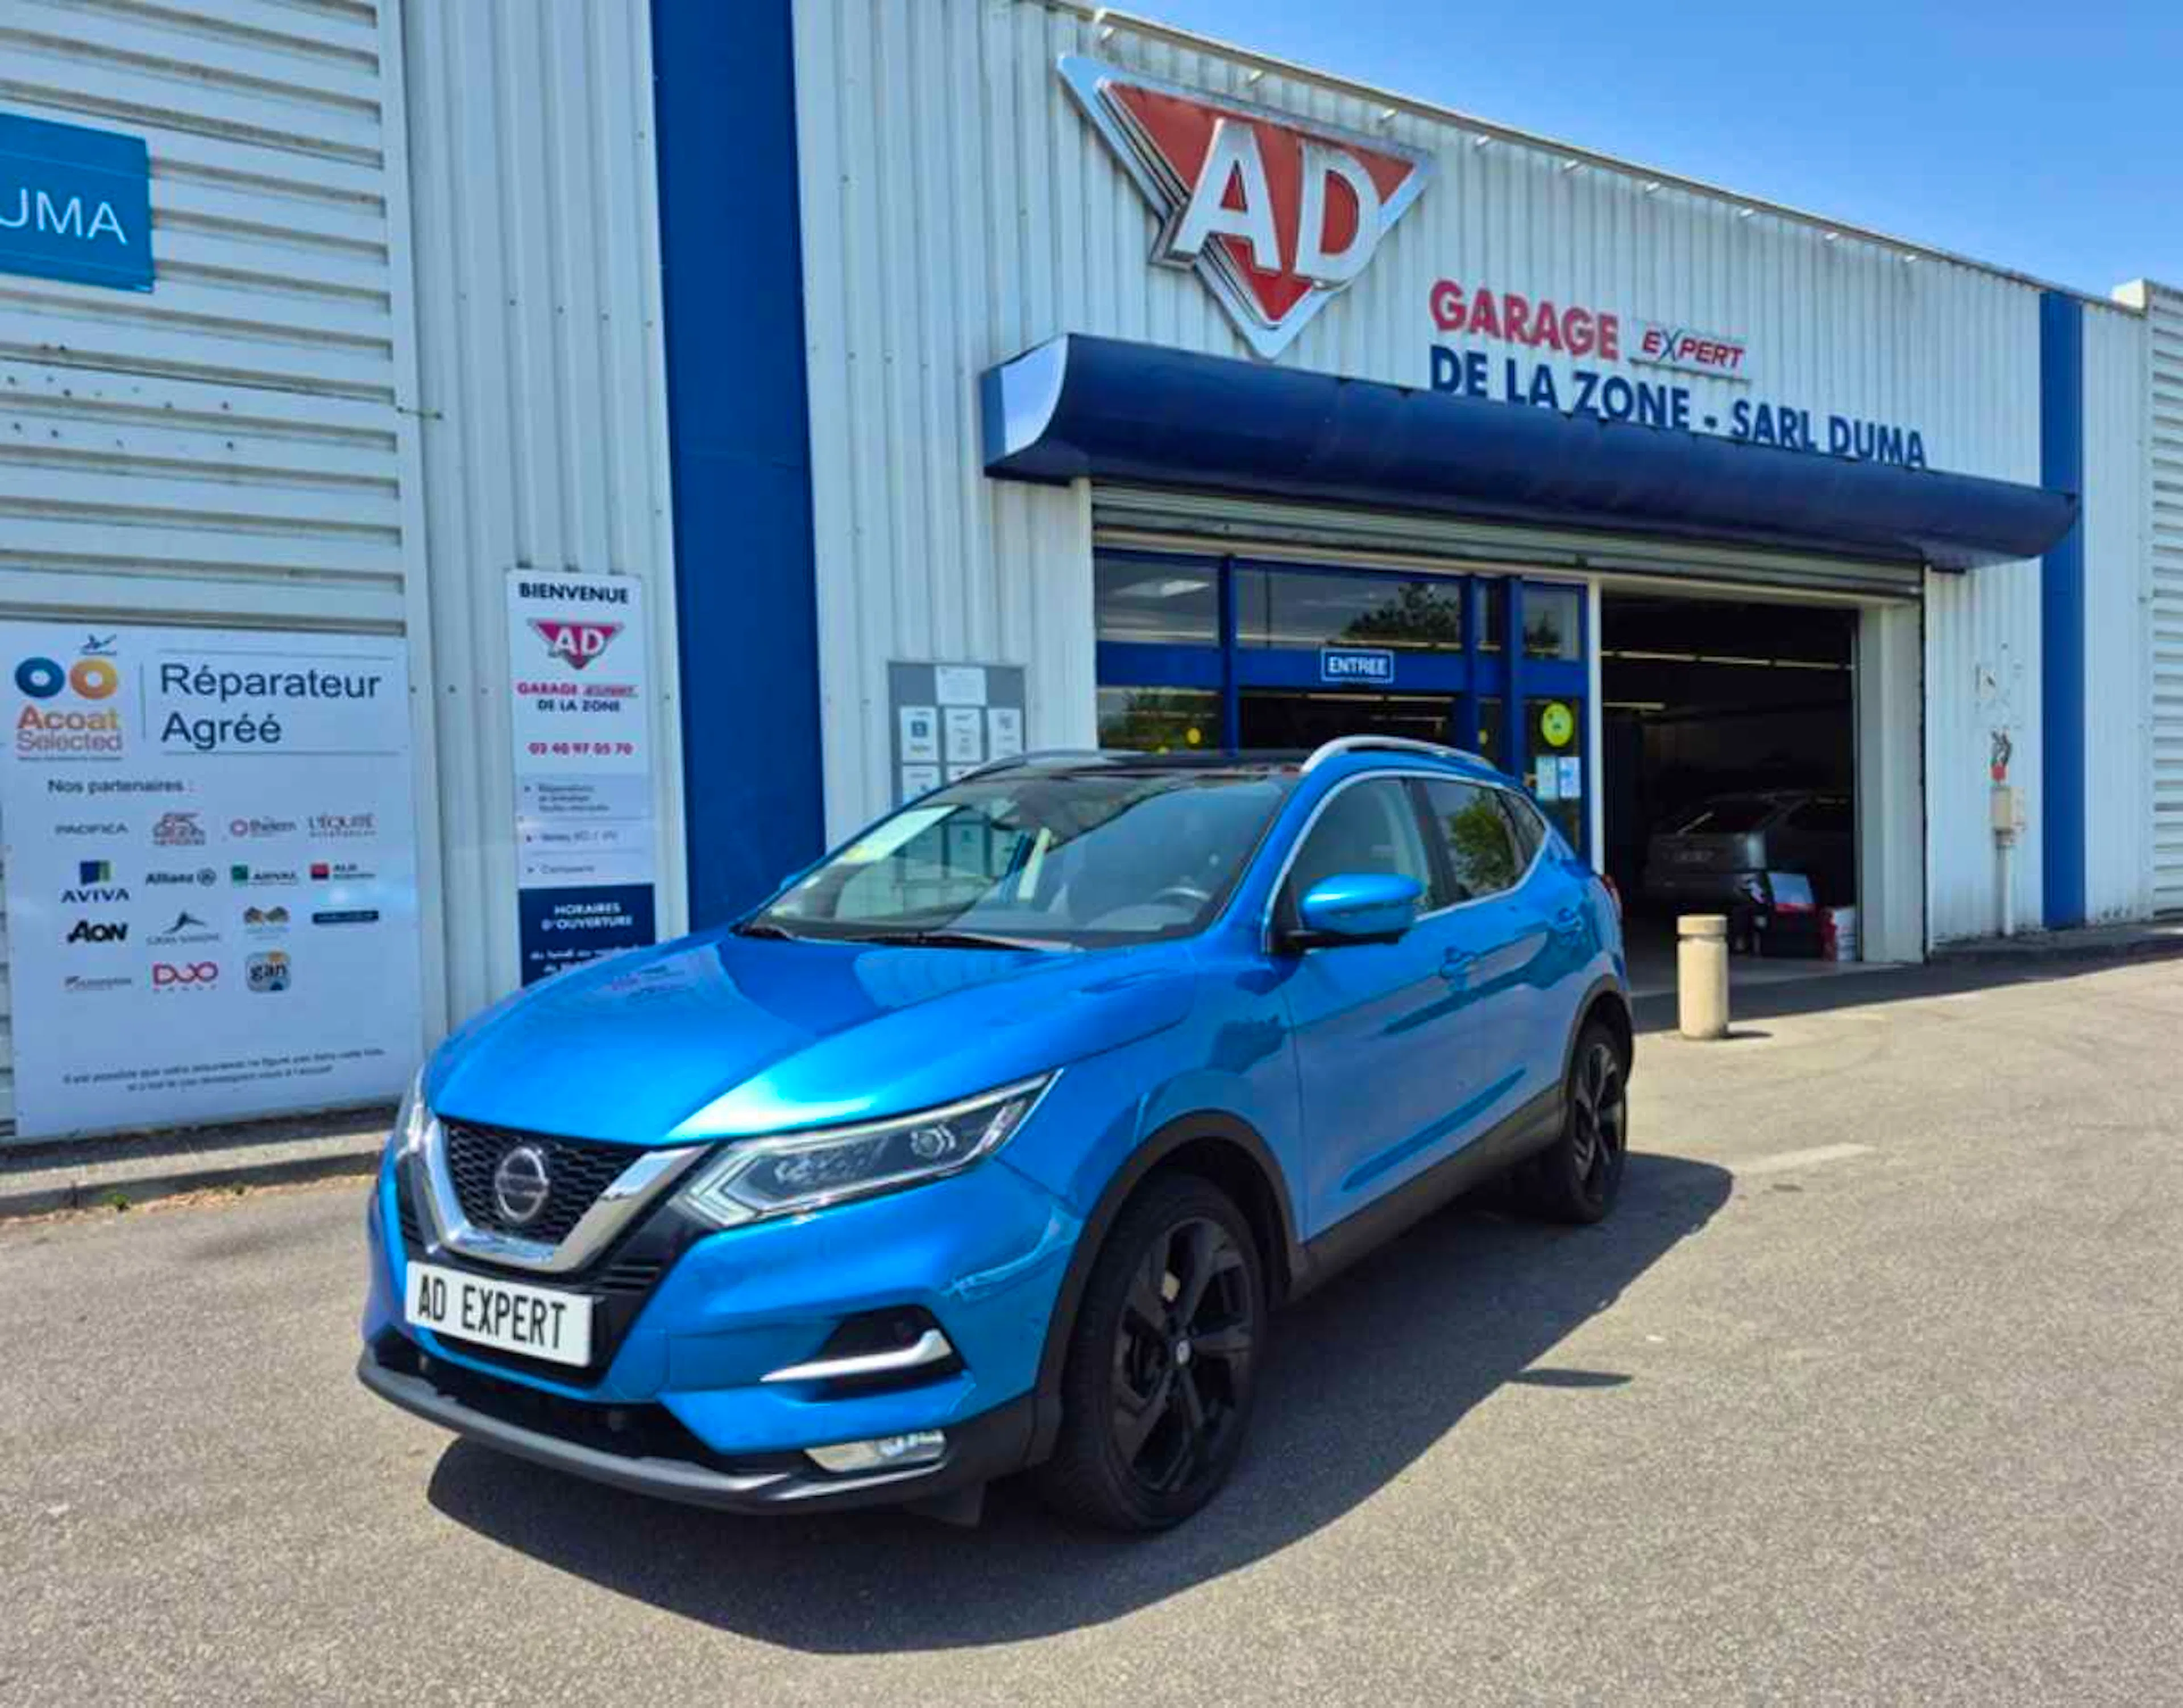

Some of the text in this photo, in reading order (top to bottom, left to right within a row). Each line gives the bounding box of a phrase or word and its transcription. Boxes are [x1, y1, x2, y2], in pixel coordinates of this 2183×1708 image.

[1159, 118, 1383, 283] AD
[1429, 279, 1746, 369] GARAGE EXPERT
[1430, 345, 1488, 397] DE
[1506, 358, 1559, 409] LA
[1573, 370, 1691, 429] ZONE
[1732, 399, 1819, 452] SARL
[1828, 414, 1927, 469] DUMA
[518, 583, 629, 604] BIENVENUE
[553, 626, 605, 656] AD
[160, 663, 381, 702] Réparateur
[17, 703, 118, 729] Acoat
[538, 699, 620, 712] DE LA ZONE
[16, 729, 122, 752] Selected
[161, 711, 282, 751] Agréé
[48, 778, 83, 793] Nos
[87, 779, 183, 796] partenaires
[61, 888, 130, 903] AVIVA
[554, 902, 622, 915] HORAIRES
[67, 919, 128, 944] AON
[418, 1274, 566, 1349] AD EXPERT
